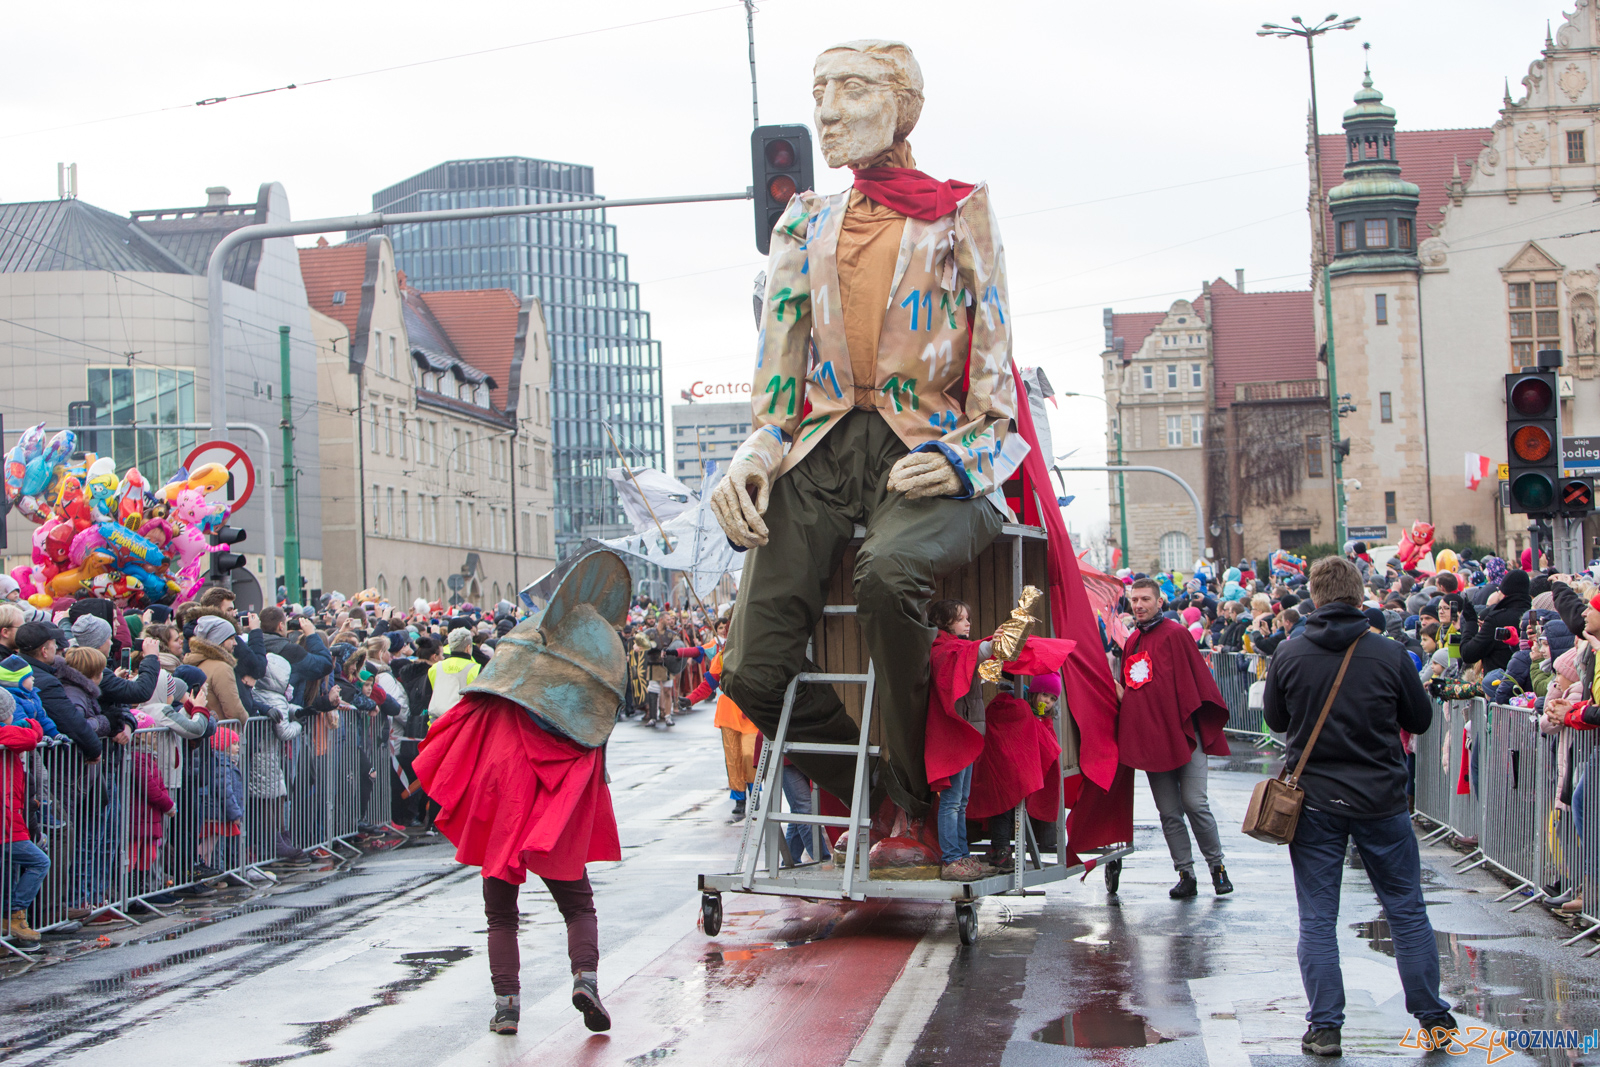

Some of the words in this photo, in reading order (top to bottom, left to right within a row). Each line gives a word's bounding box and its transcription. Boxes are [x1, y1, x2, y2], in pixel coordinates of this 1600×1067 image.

[900, 289, 932, 331] 11
[812, 360, 844, 400] 11
[921, 339, 953, 382] 11
[765, 374, 796, 416] 11
[880, 376, 919, 414] 11
